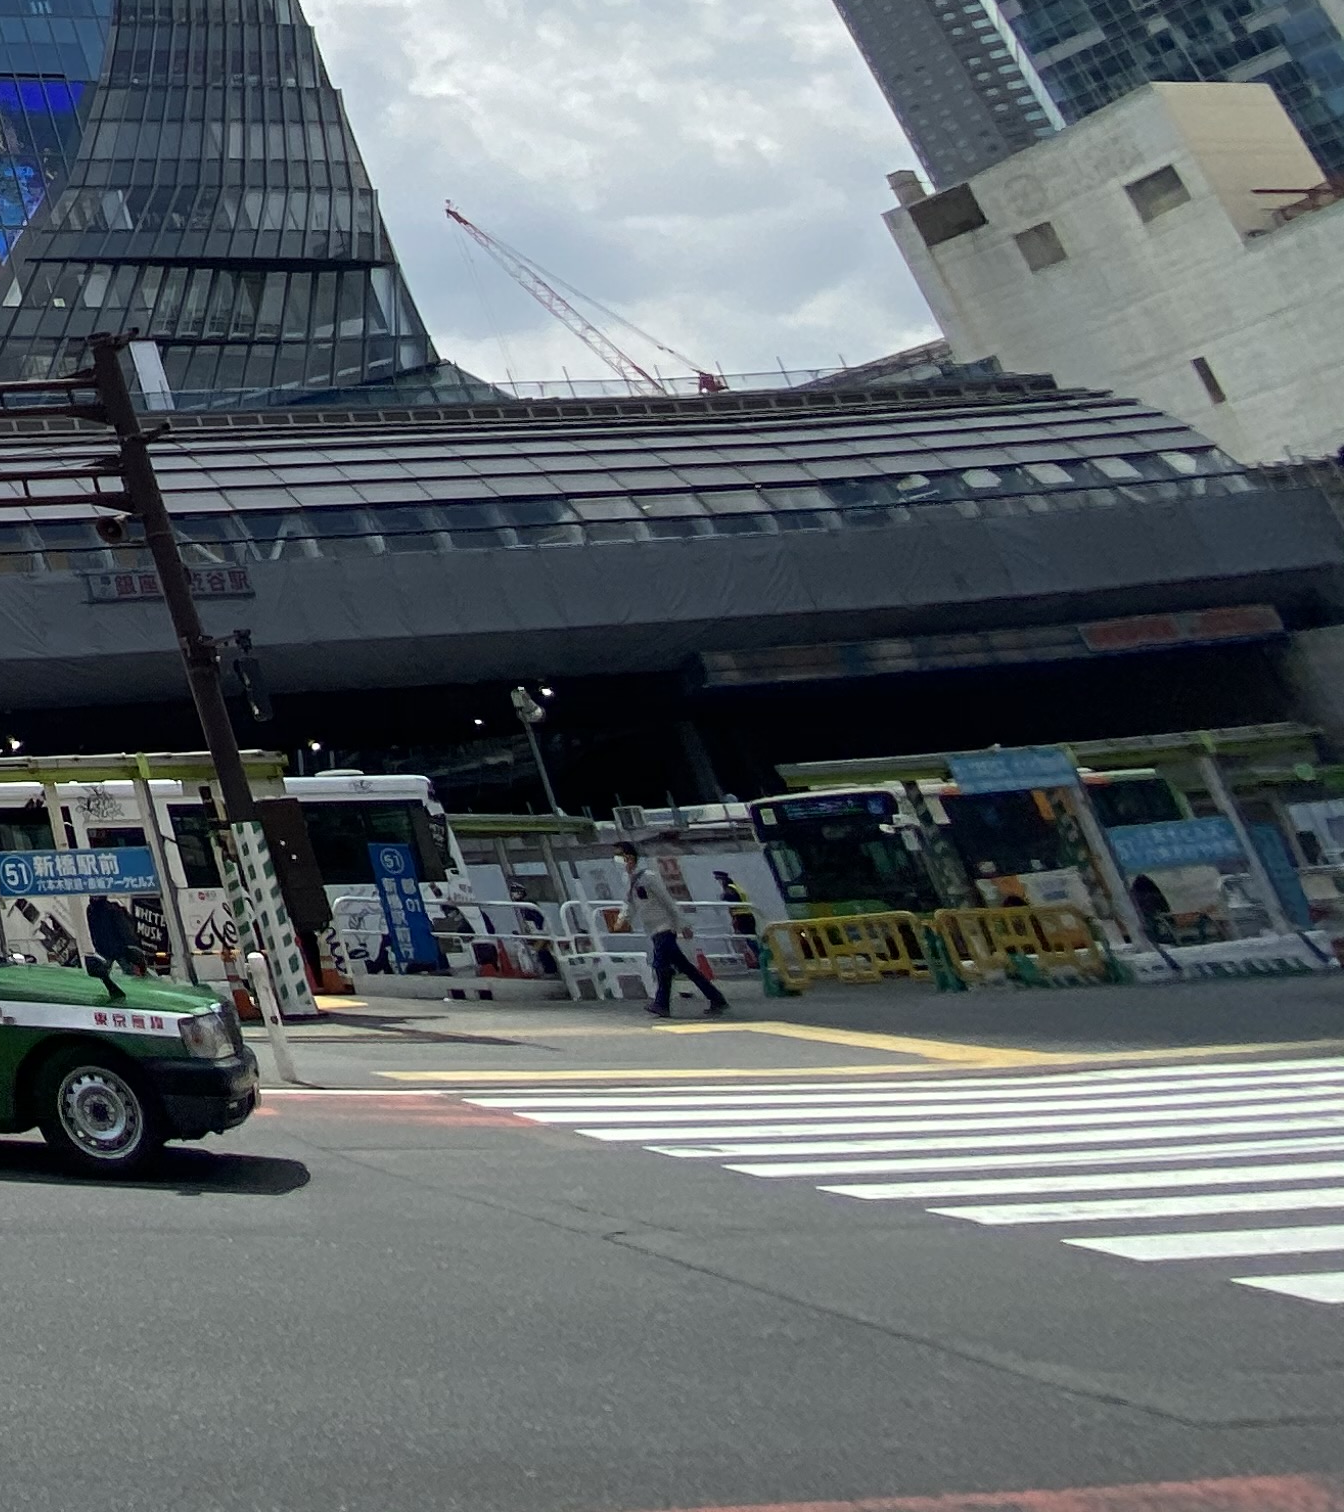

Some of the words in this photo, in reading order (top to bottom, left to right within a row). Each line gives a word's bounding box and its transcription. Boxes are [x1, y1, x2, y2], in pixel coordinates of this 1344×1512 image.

[115, 570, 248, 596] 銀座渋谷駅
[32, 853, 120, 878] 新橋駅前
[383, 854, 402, 869] 51
[4, 862, 29, 887] 51
[134, 904, 166, 927] WHITE
[136, 921, 163, 942] MUSK
